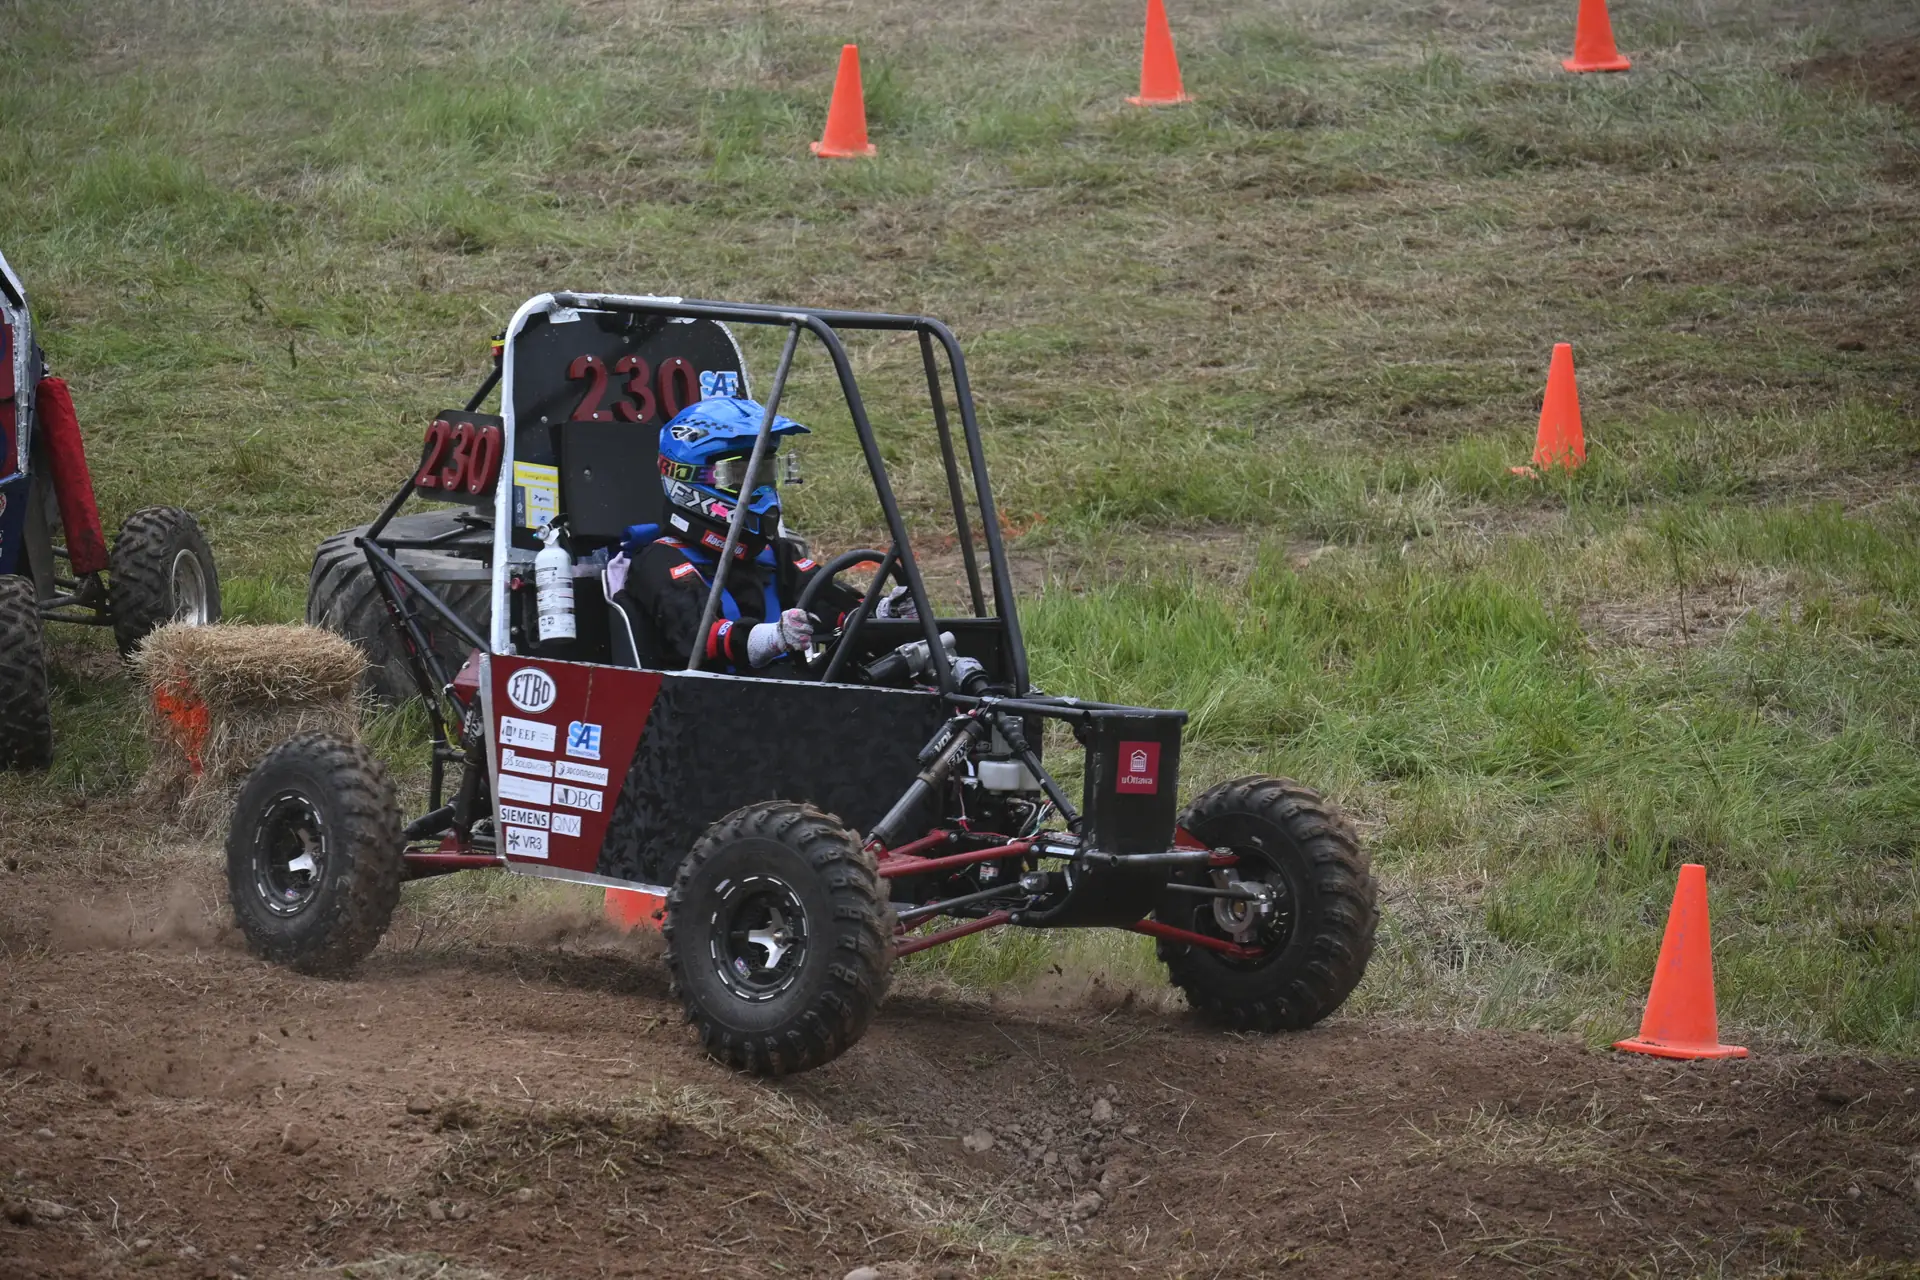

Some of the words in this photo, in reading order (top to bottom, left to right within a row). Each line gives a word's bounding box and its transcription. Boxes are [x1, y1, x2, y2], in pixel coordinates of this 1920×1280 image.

[569, 355, 699, 423] 230
[701, 371, 738, 396] SAE
[415, 419, 500, 495] 230
[512, 674, 550, 707] ETBO
[568, 722, 600, 751] SAE
[1121, 775, 1153, 785] uOttawa
[566, 788, 601, 811] DBG
[501, 808, 547, 827] SIEMENS
[553, 816, 580, 832] QNX
[522, 835, 542, 850] VR3
